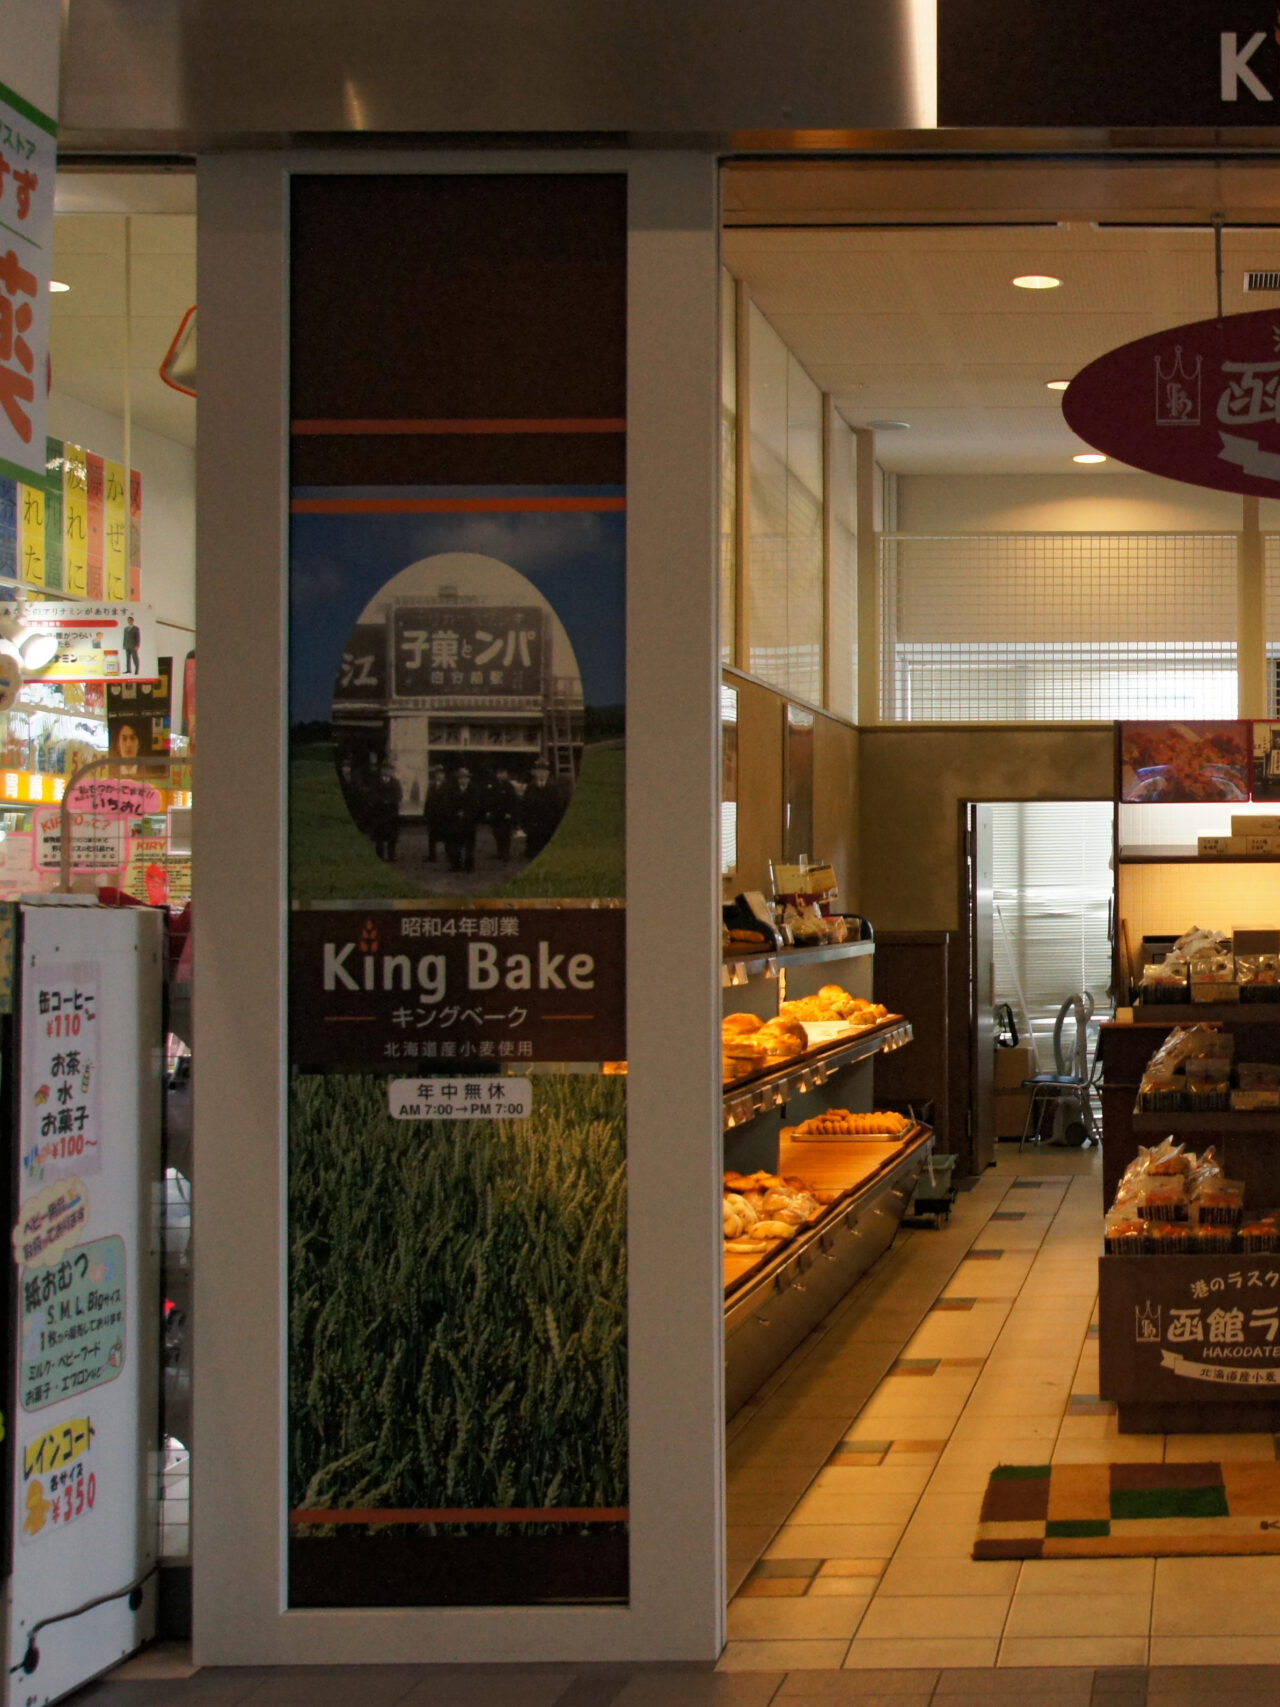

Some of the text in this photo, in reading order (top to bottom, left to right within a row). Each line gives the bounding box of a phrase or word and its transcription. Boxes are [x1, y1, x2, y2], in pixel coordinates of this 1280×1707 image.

[92, 800, 145, 816] いちおし
[400, 917, 520, 938] 昭和4年創業
[322, 941, 596, 1004] King Bake
[39, 988, 95, 1015] 缶コーヒー
[46, 1013, 81, 1038] ¥110
[391, 1006, 528, 1029] キングベーク
[383, 1041, 534, 1058] 北海道産小麦使用
[51, 1050, 81, 1077] お茶
[57, 1081, 73, 1105] 水
[417, 1084, 506, 1101] 年中無休
[41, 1105, 90, 1137] お菓子
[399, 1103, 525, 1116] AM 7:00 PM 7:00
[25, 1253, 90, 1314] 紙おむつ
[23, 1416, 96, 1482] レインコート
[50, 1462, 84, 1493] 各サイズ
[52, 1472, 97, 1525] ¥350
